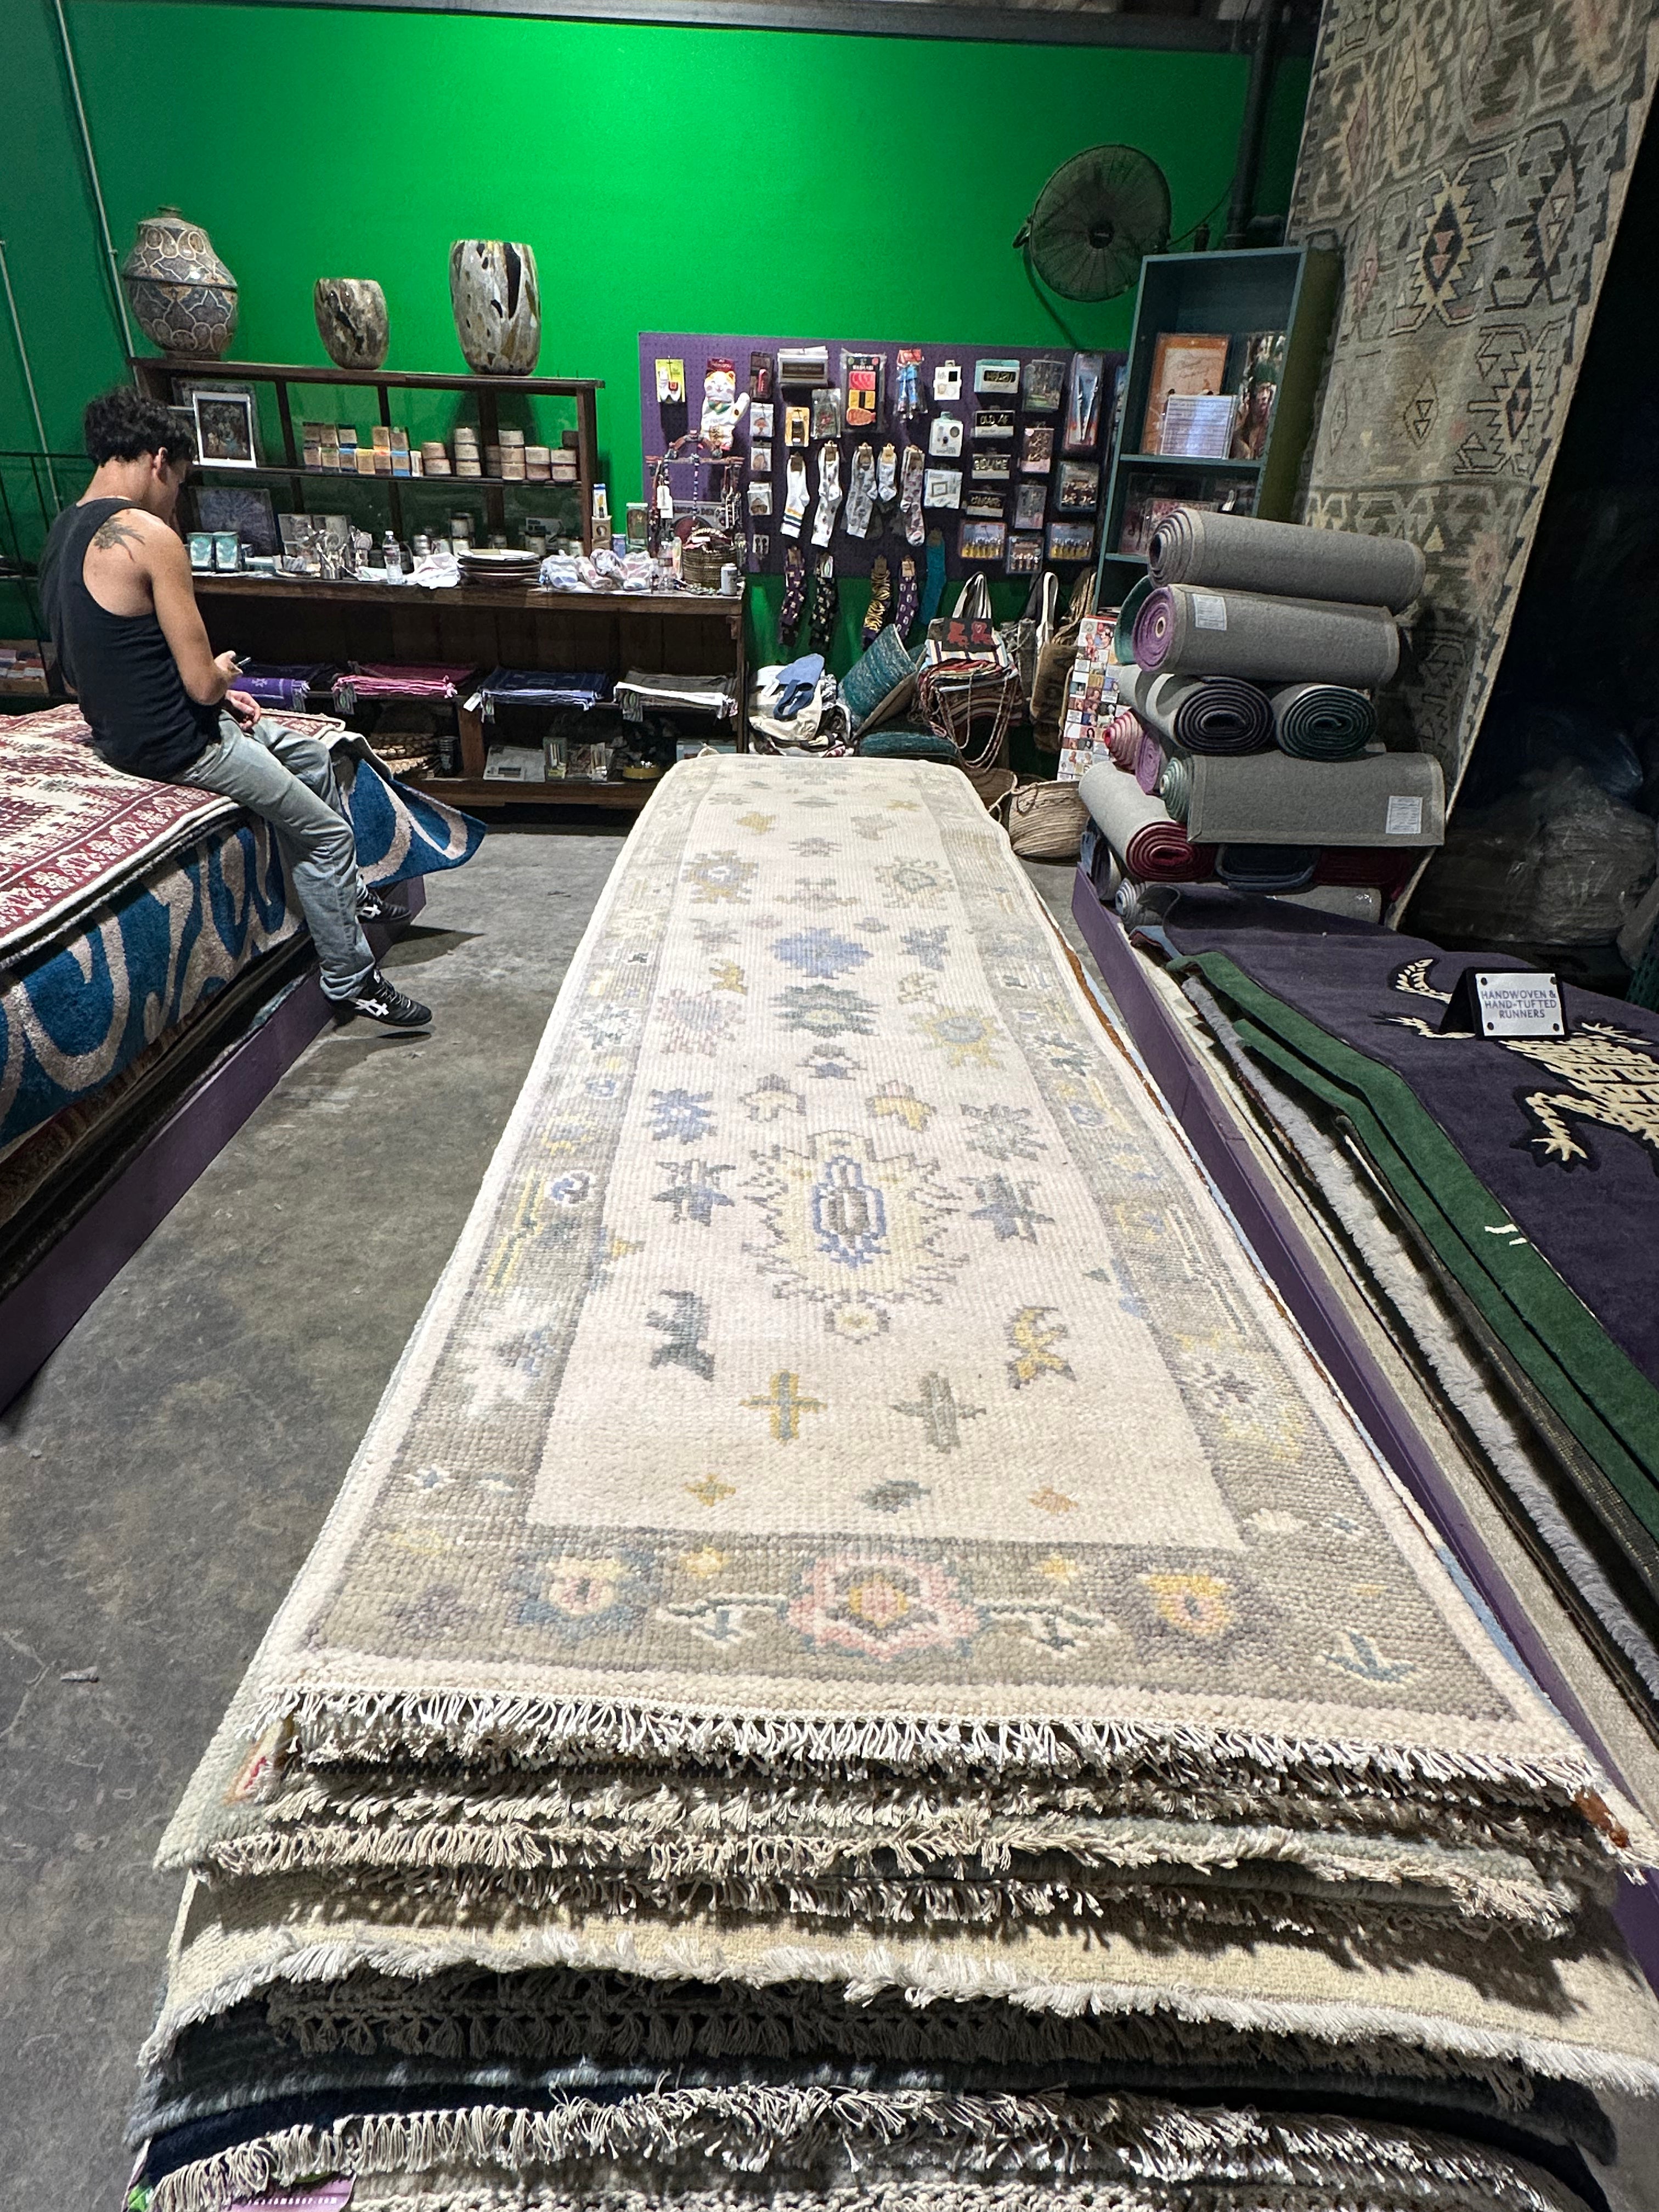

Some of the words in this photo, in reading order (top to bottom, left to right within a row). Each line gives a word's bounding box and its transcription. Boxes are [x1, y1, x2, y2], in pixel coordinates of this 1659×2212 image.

[1481, 990, 1547, 999] HANDWOVEN
[1549, 990, 1556, 998] &
[1485, 1000, 1557, 1008] HAND-TUFTED
[1499, 1009, 1545, 1018] RUNNERS
